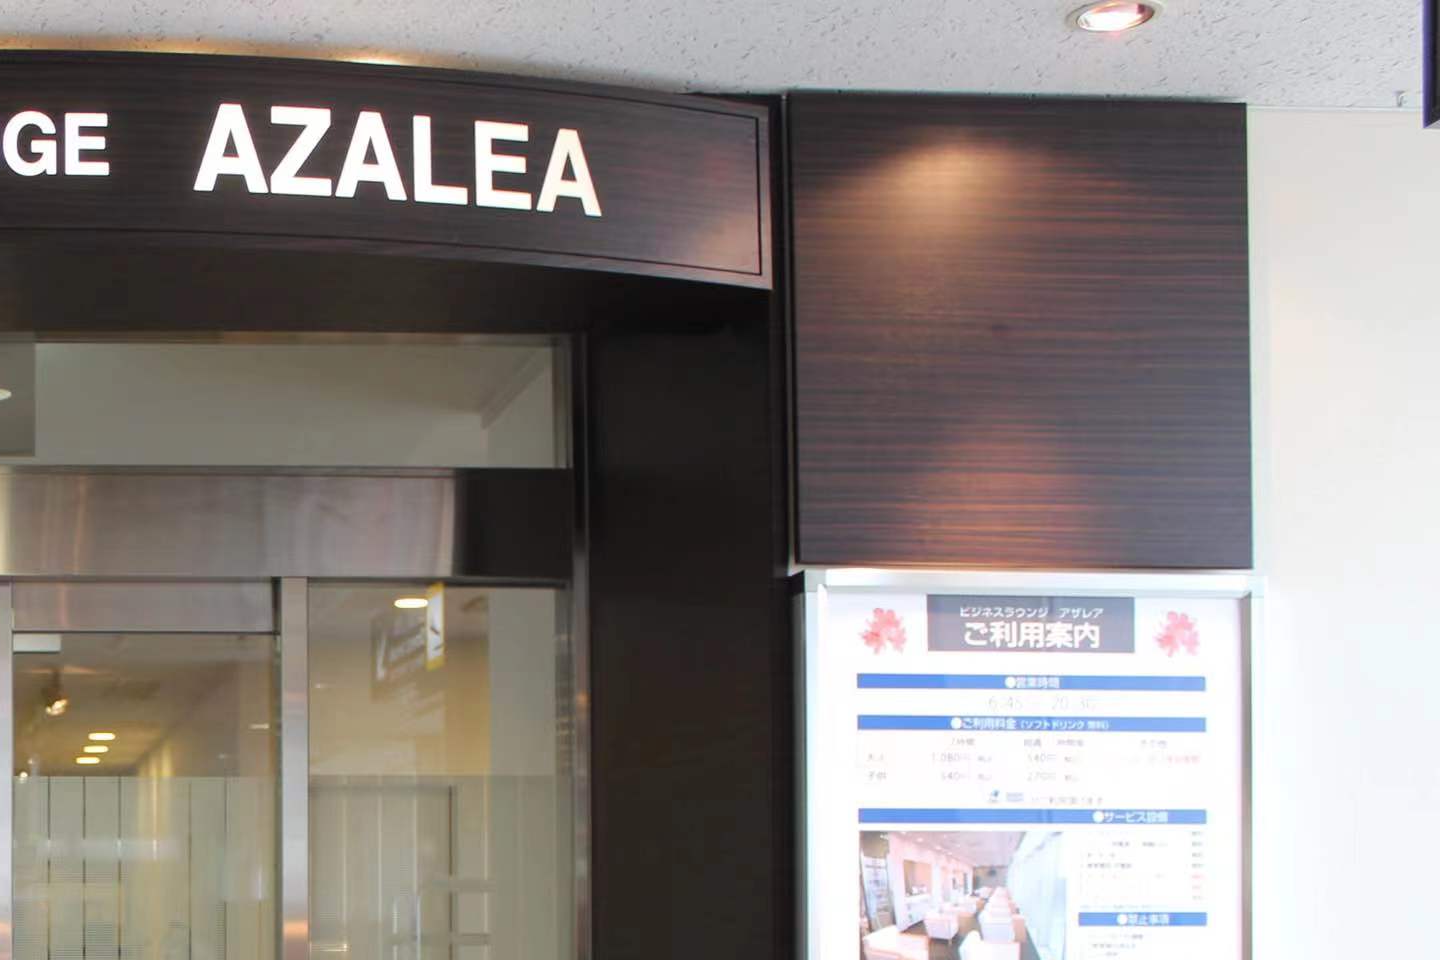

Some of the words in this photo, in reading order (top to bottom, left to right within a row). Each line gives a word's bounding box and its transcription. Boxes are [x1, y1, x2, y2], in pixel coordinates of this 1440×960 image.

[194, 103, 602, 217] AZALEA
[959, 606, 1049, 619] ビジネスラウンジ
[1058, 607, 1104, 619] アザレア
[964, 620, 1101, 649] ご利用案内
